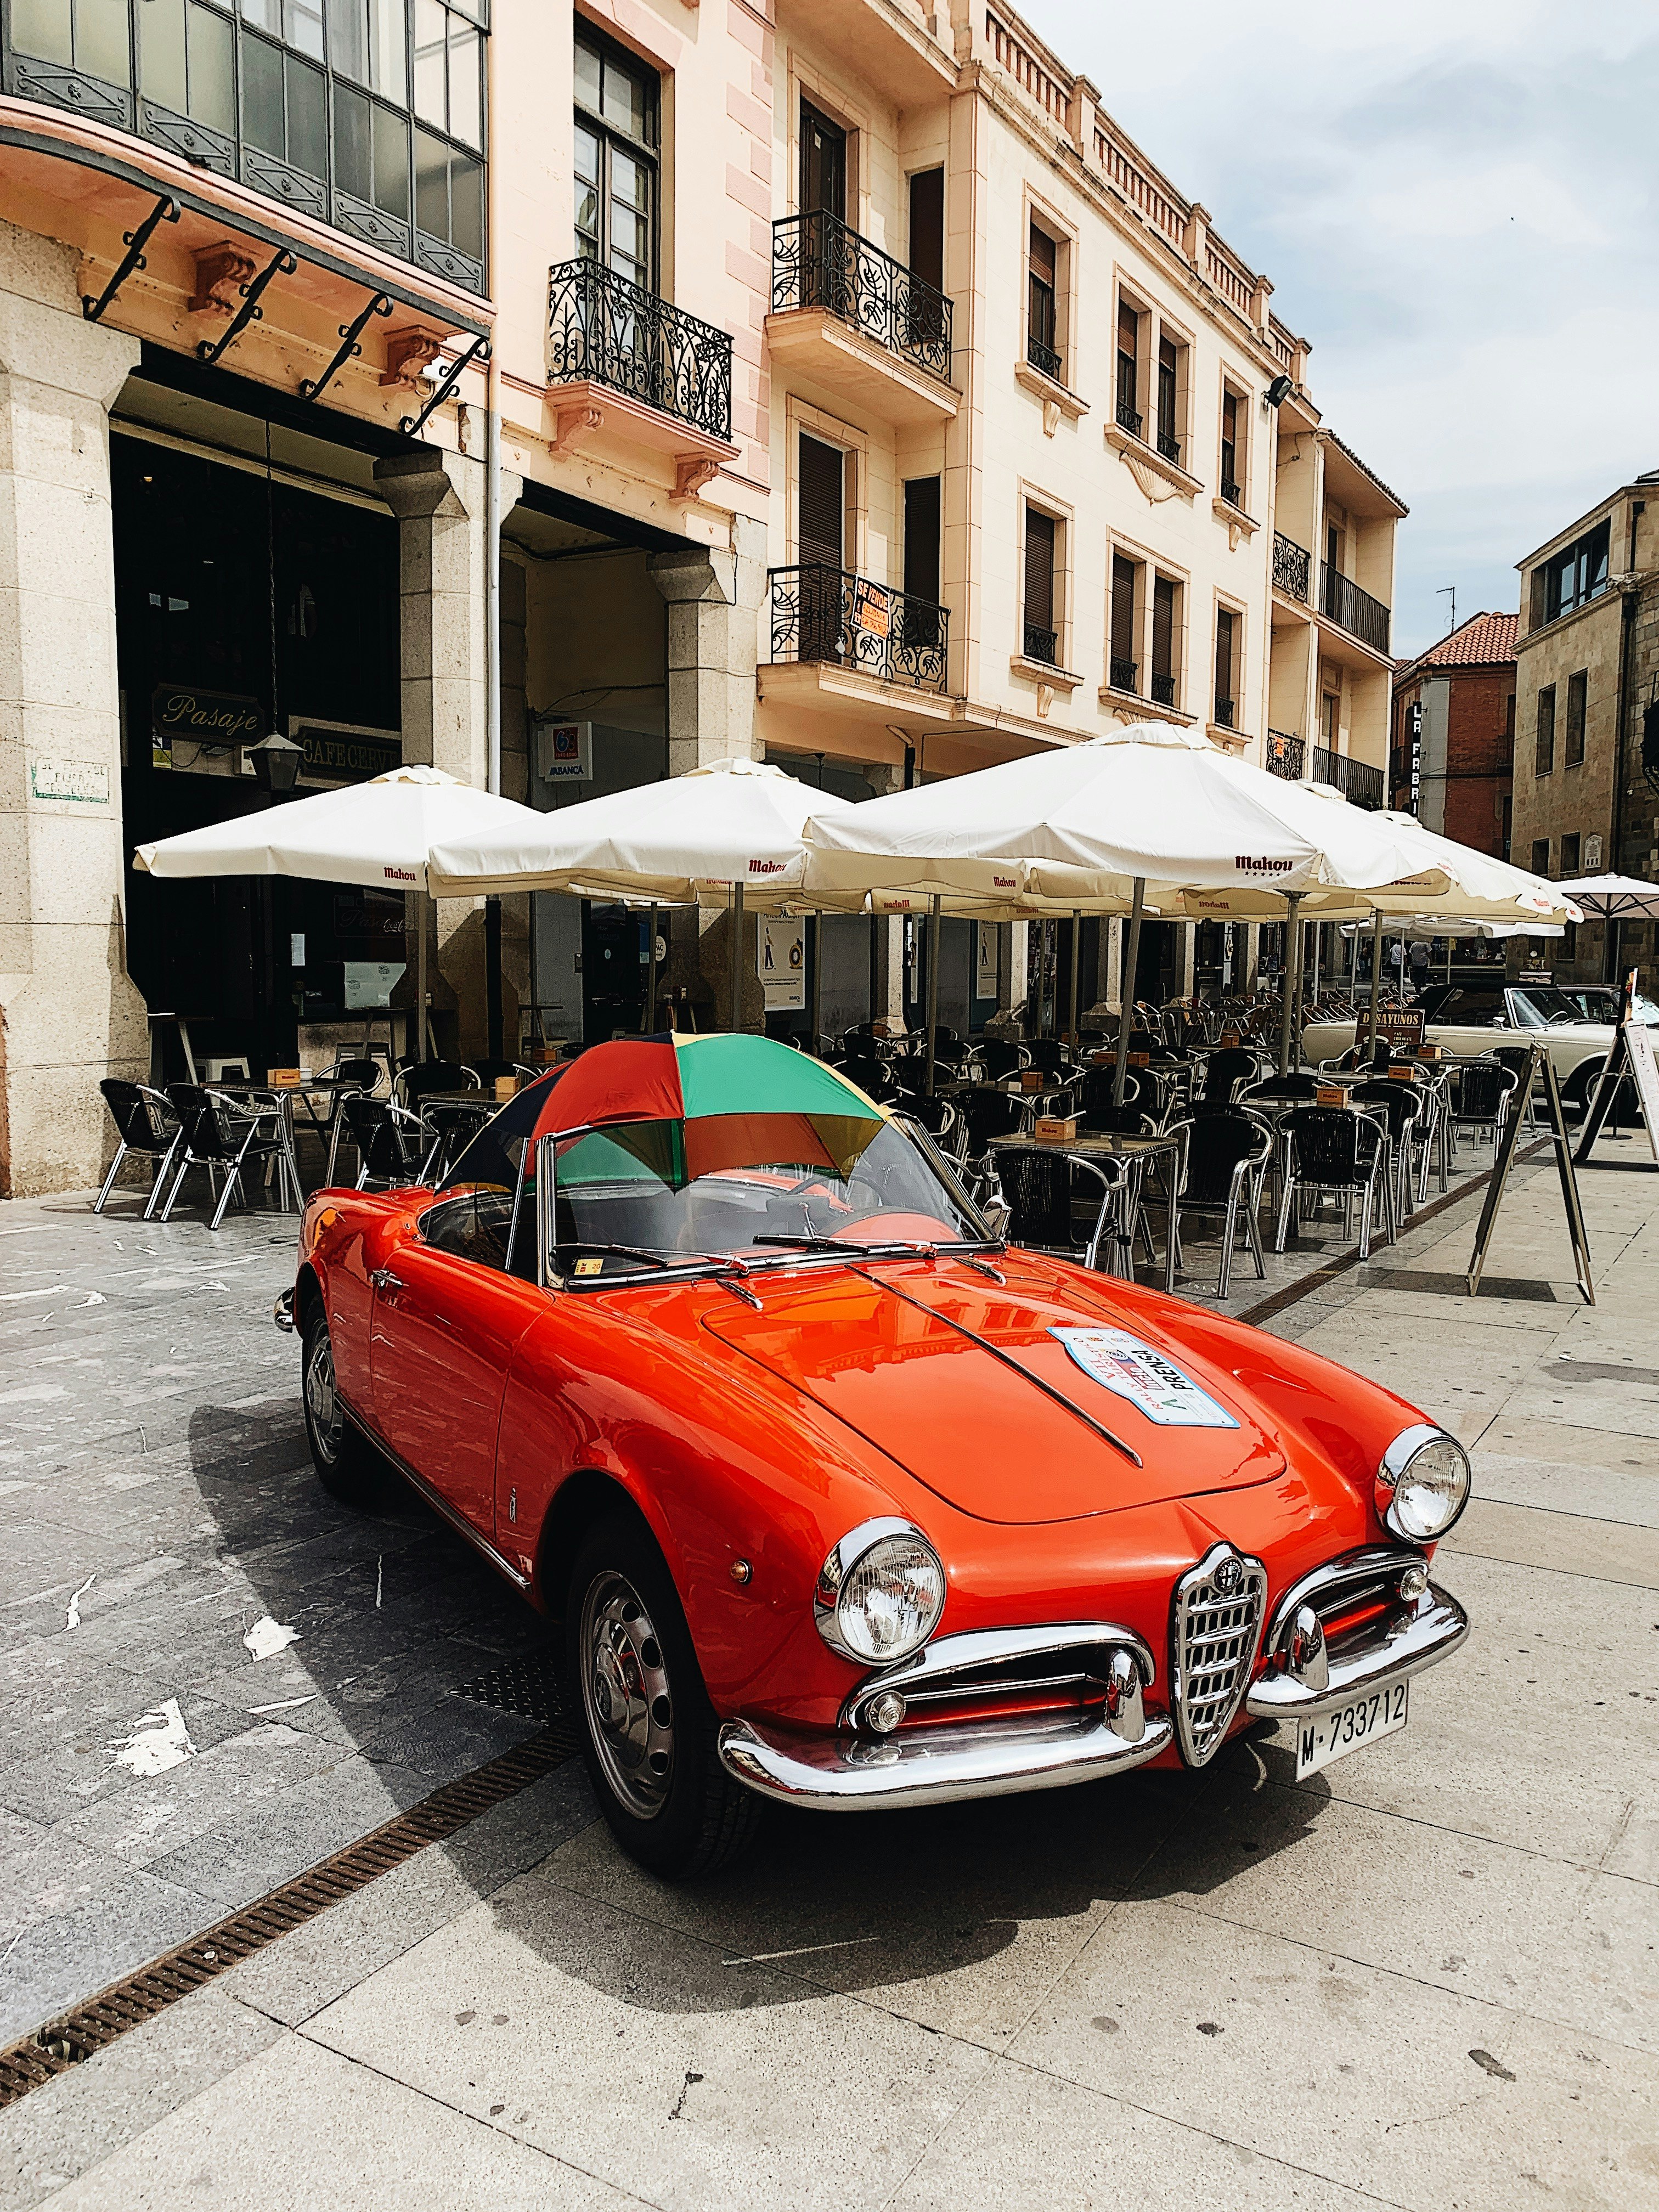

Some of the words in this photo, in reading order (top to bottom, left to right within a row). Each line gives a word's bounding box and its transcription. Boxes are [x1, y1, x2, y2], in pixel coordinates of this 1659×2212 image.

[858, 581, 868, 598] SE
[868, 586, 888, 611] VENDE
[162, 695, 257, 736] Pasaje
[1413, 706, 1421, 732] LA
[303, 739, 346, 766] CAFE
[550, 765, 584, 775] ABANCA
[1411, 743, 1420, 814] FABRI
[384, 867, 416, 881] Mahou
[749, 860, 787, 873] Mahou
[1235, 856, 1293, 871] Mahou
[993, 877, 1016, 887] Mahou
[1362, 1013, 1419, 1025] DSAYUNOS
[1088, 1359, 1116, 1379] VII
[1131, 1350, 1194, 1390] PRENSA
[1126, 1382, 1164, 1409] RALLY
